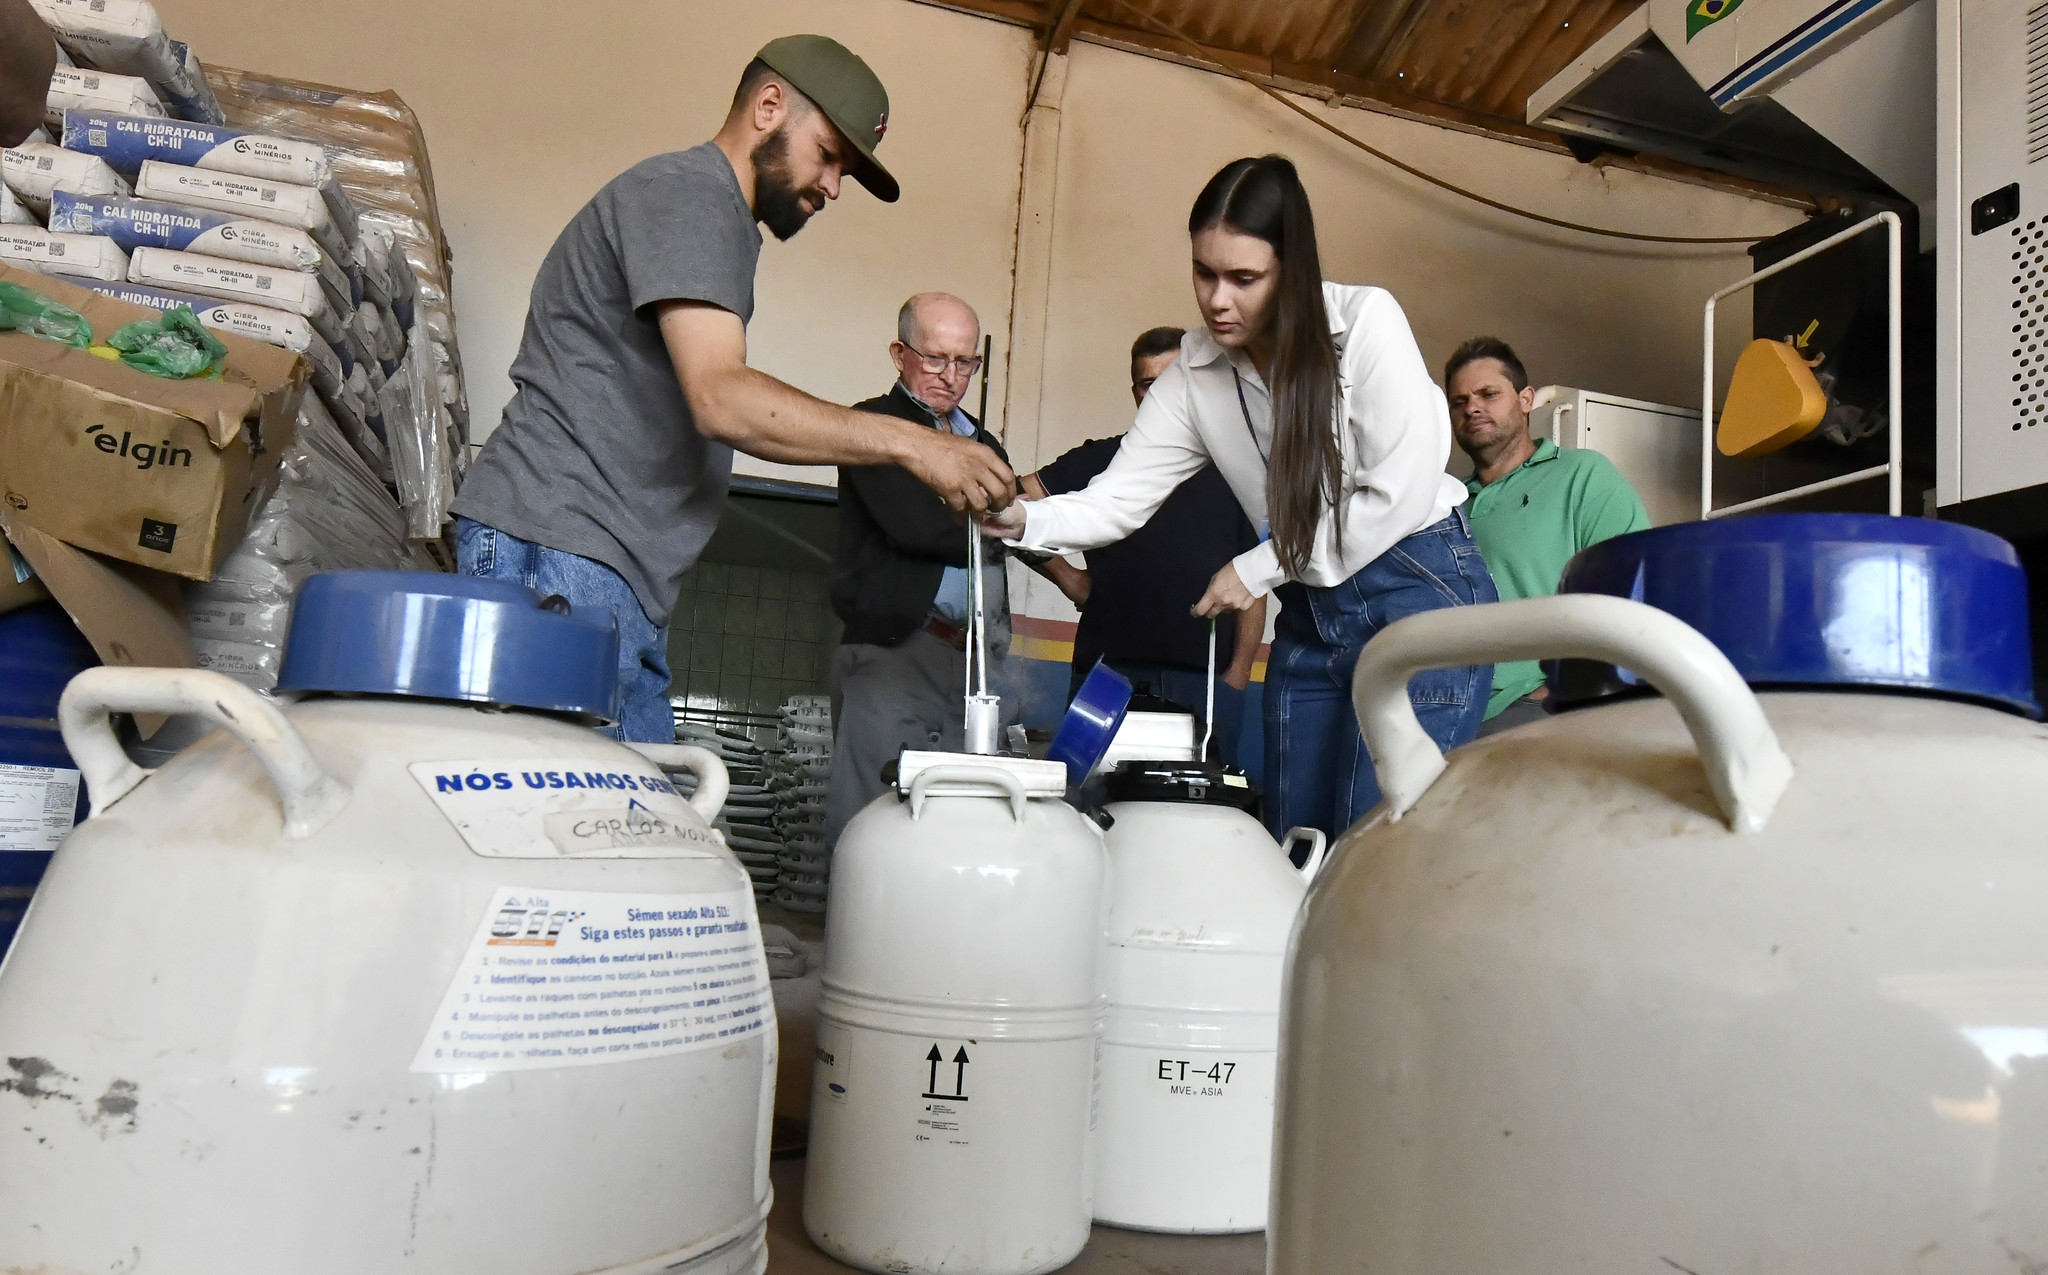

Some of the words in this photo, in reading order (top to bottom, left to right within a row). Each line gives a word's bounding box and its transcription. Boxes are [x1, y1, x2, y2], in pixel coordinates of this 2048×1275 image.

[89, 119, 108, 128] 20kg
[116, 121, 140, 132] CAL
[144, 123, 215, 143] HIDRATADA
[148, 135, 182, 150] CH-III
[255, 142, 279, 151] CIBRA
[254, 149, 292, 161] MINÉRIOS
[225, 181, 258, 192] HIDRATADA
[225, 188, 243, 197] CH-III
[74, 202, 94, 212] 20kg
[103, 206, 127, 219] CAL
[130, 209, 201, 230] HIDRATADA
[134, 222, 169, 237] CH-III
[242, 229, 266, 238] CIBRA
[12, 237, 46, 247] HIDRATADA
[241, 236, 280, 248] MINÉRIOS
[14, 245, 32, 253] CH-III
[219, 269, 253, 279] HIDRATADA
[220, 275, 238, 284] CH-III
[234, 312, 258, 321] CIBRA
[233, 319, 272, 331] MINÉRIOS
[93, 428, 192, 469] elgin
[154, 525, 164, 536] 3
[435, 767, 513, 793] NÓS
[521, 771, 639, 792] USAMOS
[573, 818, 666, 838] CARLOS
[526, 897, 550, 907] Alta
[627, 908, 664, 922] Sêmen
[667, 907, 697, 920] sexado
[700, 905, 715, 918] Alta
[580, 927, 609, 942] Siga
[614, 927, 645, 939] estes
[650, 927, 683, 940] passos
[686, 928, 691, 936] e
[694, 923, 722, 938] garanta
[483, 957, 488, 966] 1
[499, 956, 533, 966] Revise
[536, 958, 548, 966] as
[550, 954, 596, 966] condições
[599, 953, 610, 963] do
[612, 953, 646, 963] material
[648, 953, 664, 962] para
[474, 975, 481, 984] 2
[491, 974, 547, 986] Identifique
[549, 976, 561, 984] as
[564, 974, 602, 982] canecas
[463, 993, 470, 1003] 3
[480, 993, 522, 1003] Levante
[525, 995, 538, 1003] as
[577, 992, 598, 1001] com
[600, 989, 637, 1000] palhetas
[451, 1011, 459, 1021] 4
[469, 1011, 520, 1023] Manipule
[523, 1013, 535, 1022] as
[538, 1010, 581, 1022] palhetas
[583, 1009, 609, 1019] antes
[611, 1007, 622, 1016] do
[443, 1030, 451, 1041] 5
[460, 1030, 524, 1043] Descongele
[528, 1031, 540, 1040] as
[542, 1028, 585, 1041] palhetas
[602, 1021, 660, 1035] descongelador
[435, 1048, 443, 1058] 6
[452, 1048, 500, 1061] Enxugue
[568, 1045, 589, 1056] faça
[591, 1045, 607, 1055] um
[608, 1043, 630, 1053] corte
[1158, 1059, 1236, 1084] ET-47
[1200, 1087, 1223, 1097] ASIA
